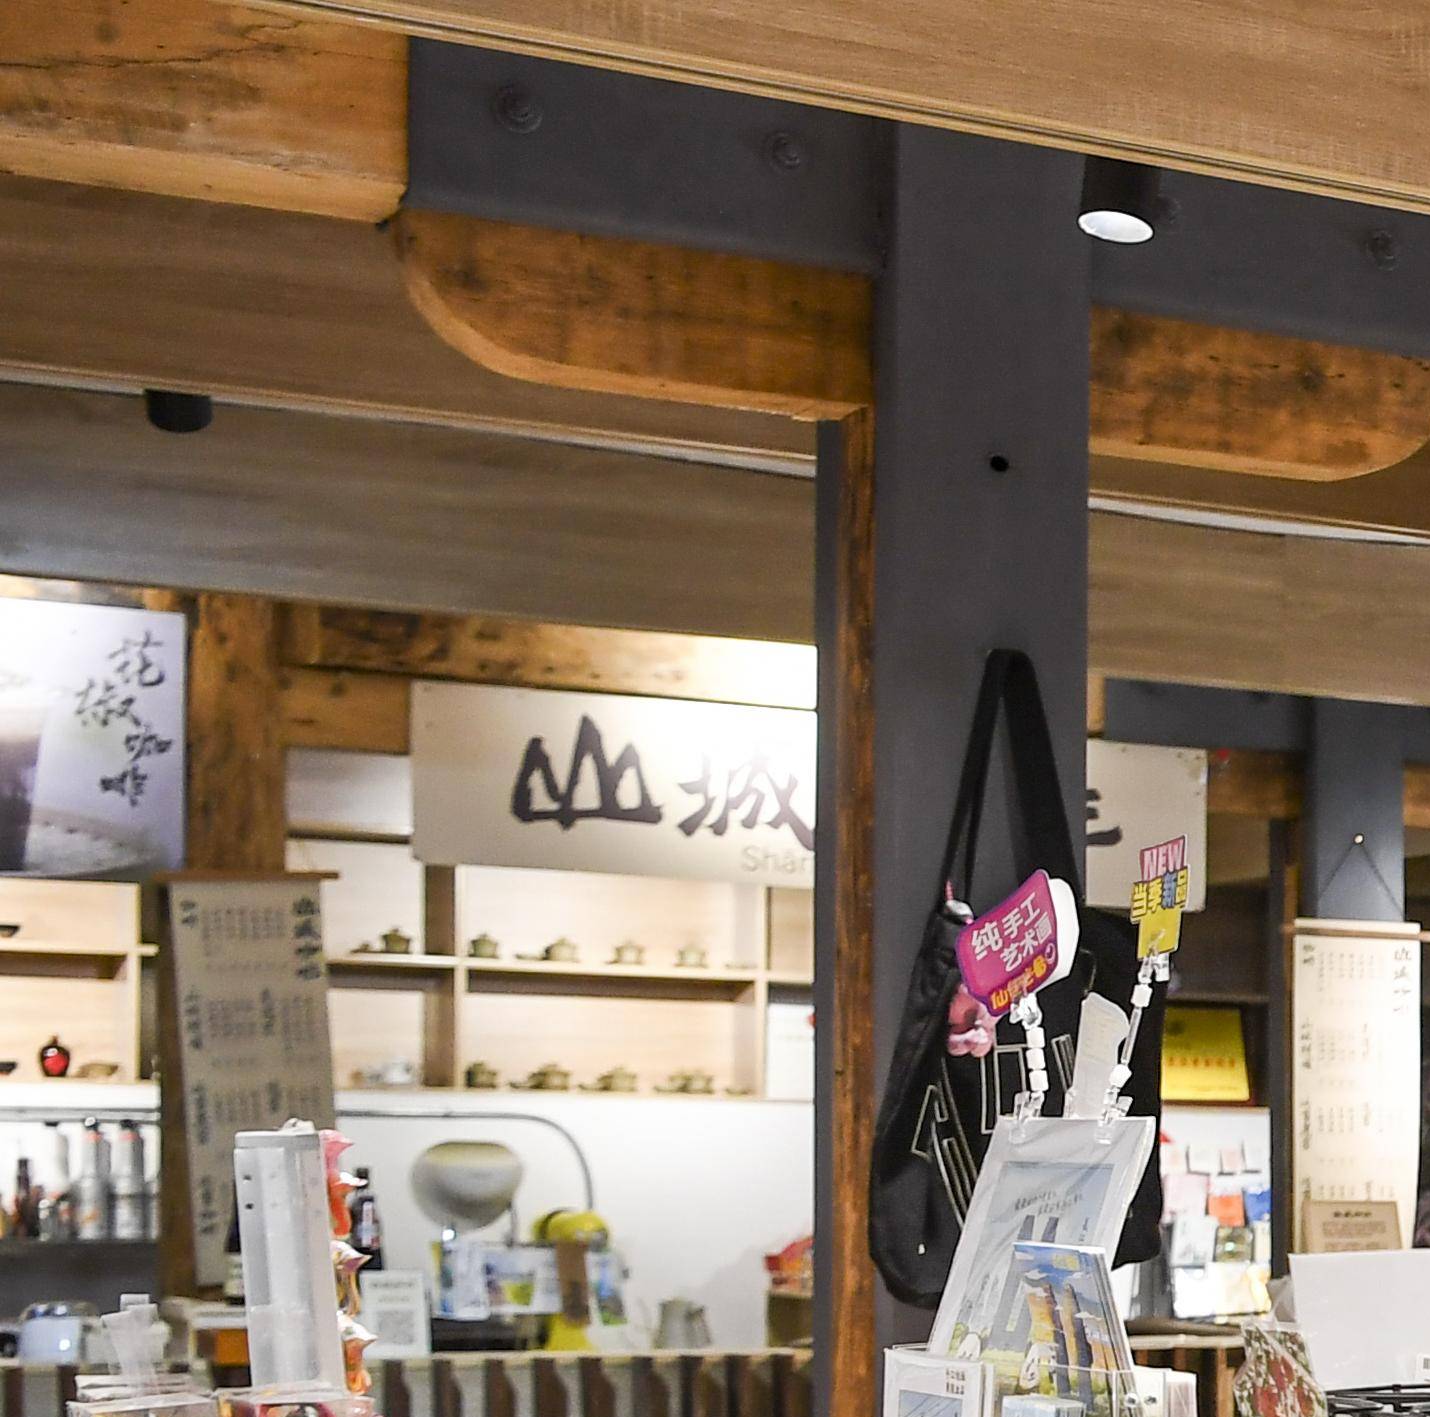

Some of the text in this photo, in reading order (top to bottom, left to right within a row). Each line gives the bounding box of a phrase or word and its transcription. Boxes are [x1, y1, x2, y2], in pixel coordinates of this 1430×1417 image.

[1143, 839, 1186, 879] NEW
[1132, 868, 1188, 918] 当季新品
